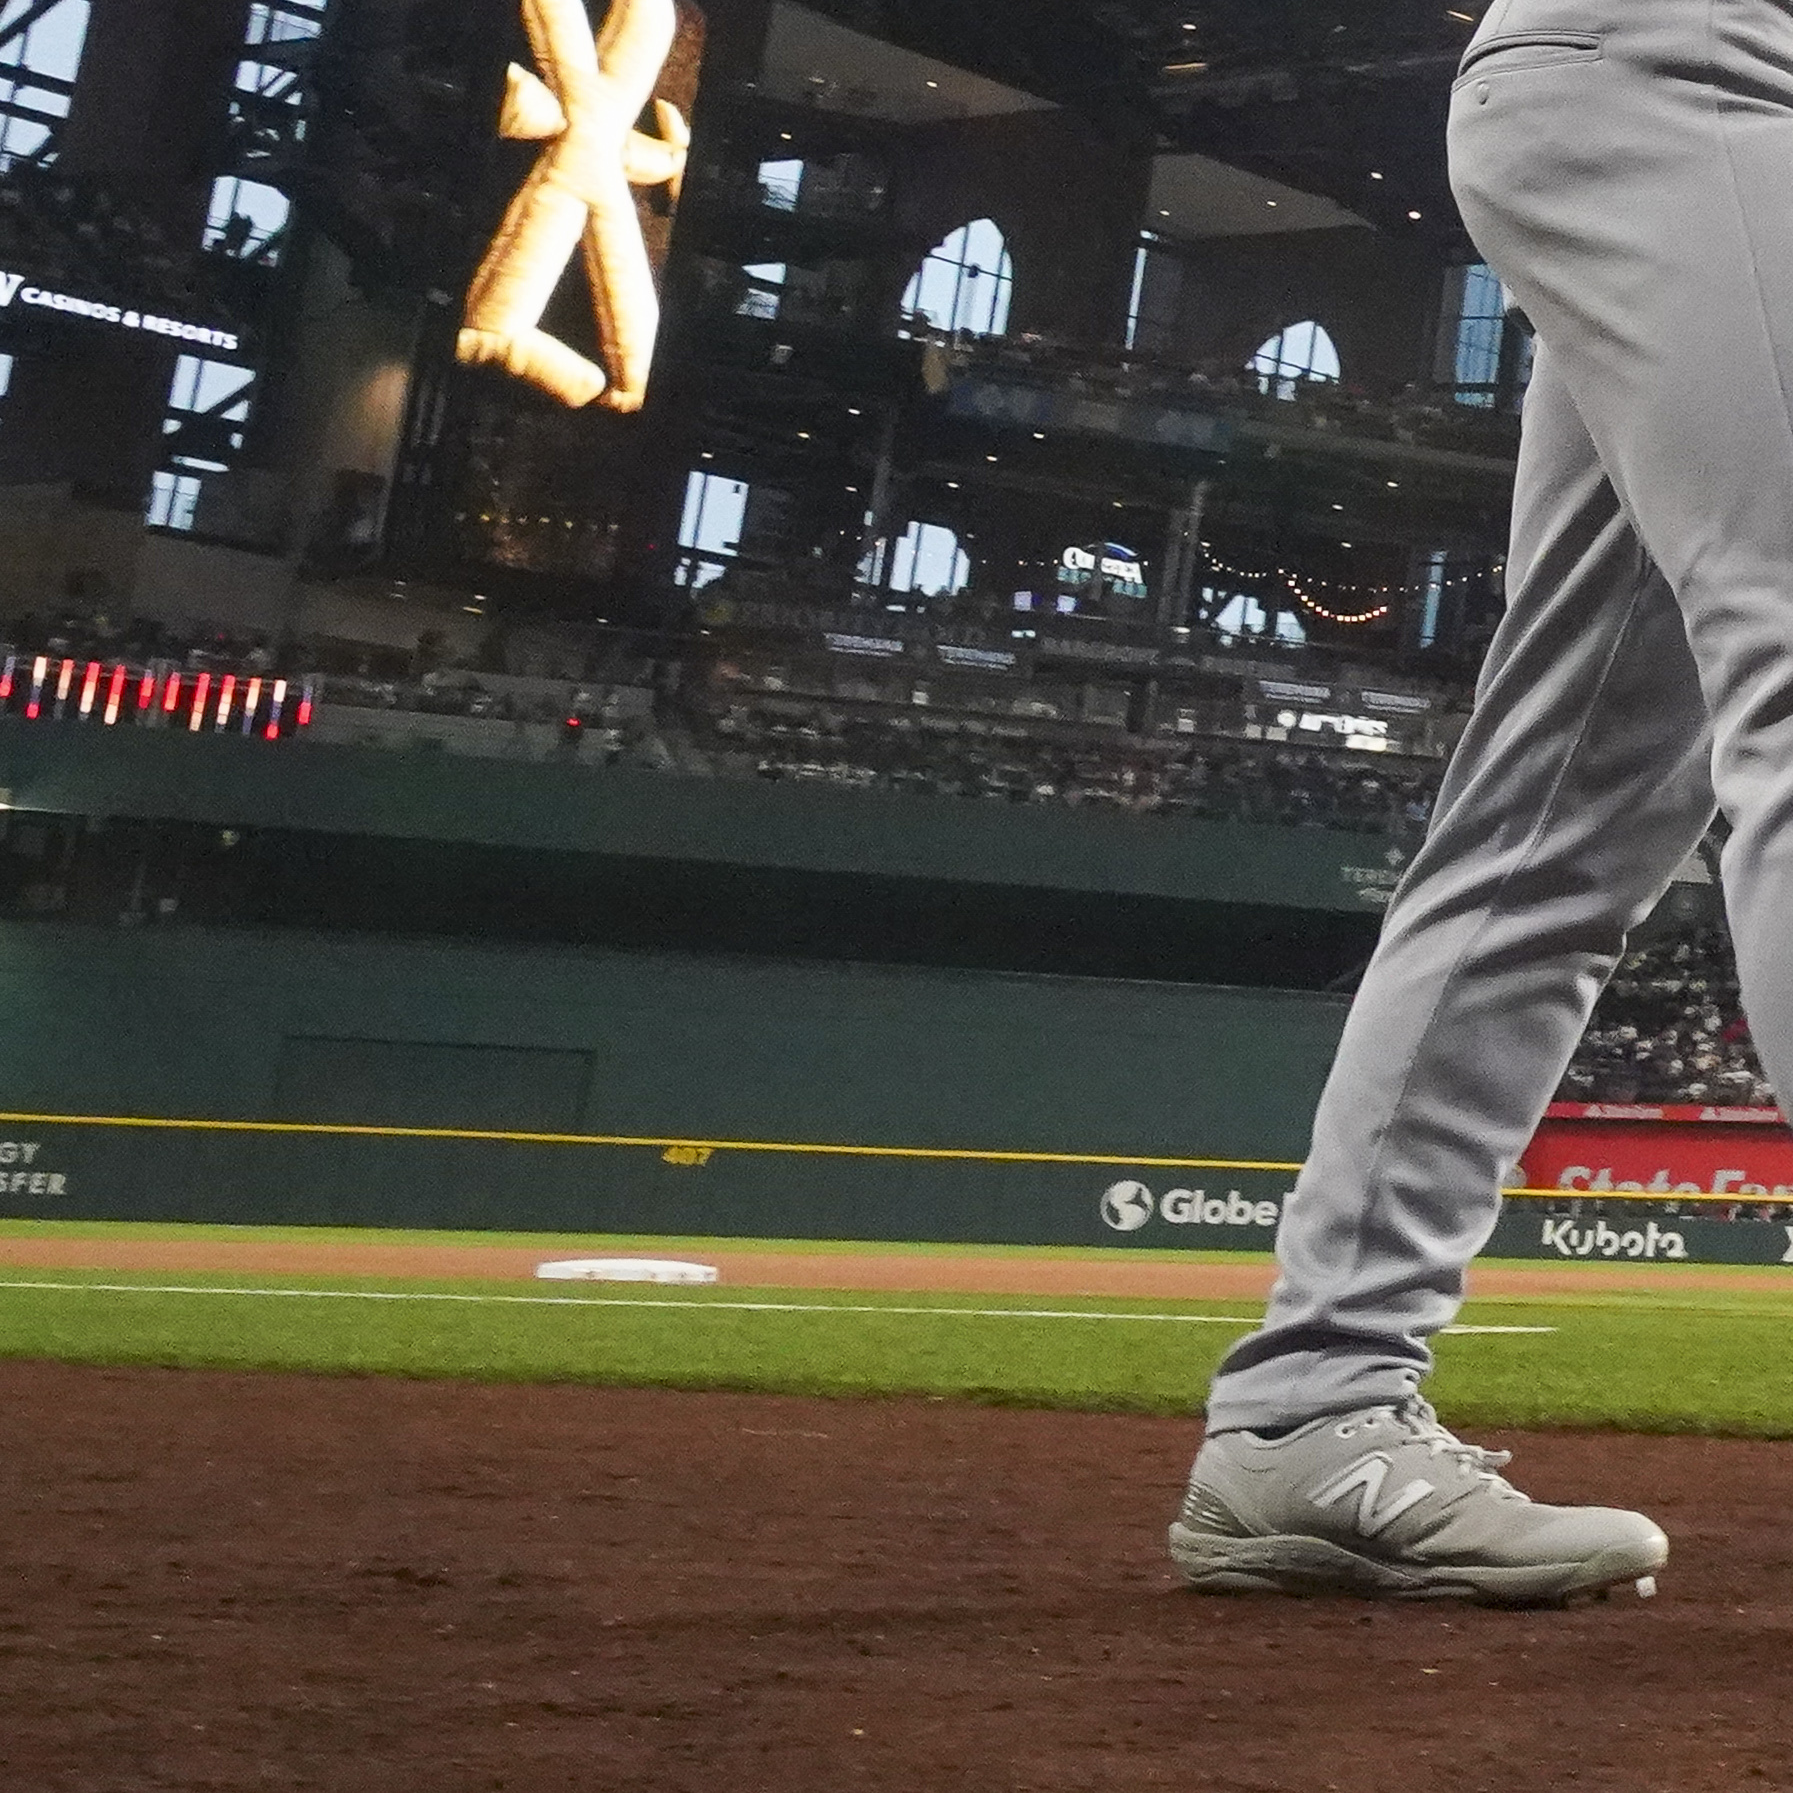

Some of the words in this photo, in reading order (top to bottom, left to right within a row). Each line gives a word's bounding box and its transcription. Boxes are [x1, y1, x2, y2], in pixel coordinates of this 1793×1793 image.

[20, 287, 122, 323] CASINOS
[122, 310, 140, 328] &
[142, 314, 238, 350] RESORTS
[1160, 1188, 1280, 1227] Globe
[1541, 1218, 1689, 1258] Kubota
